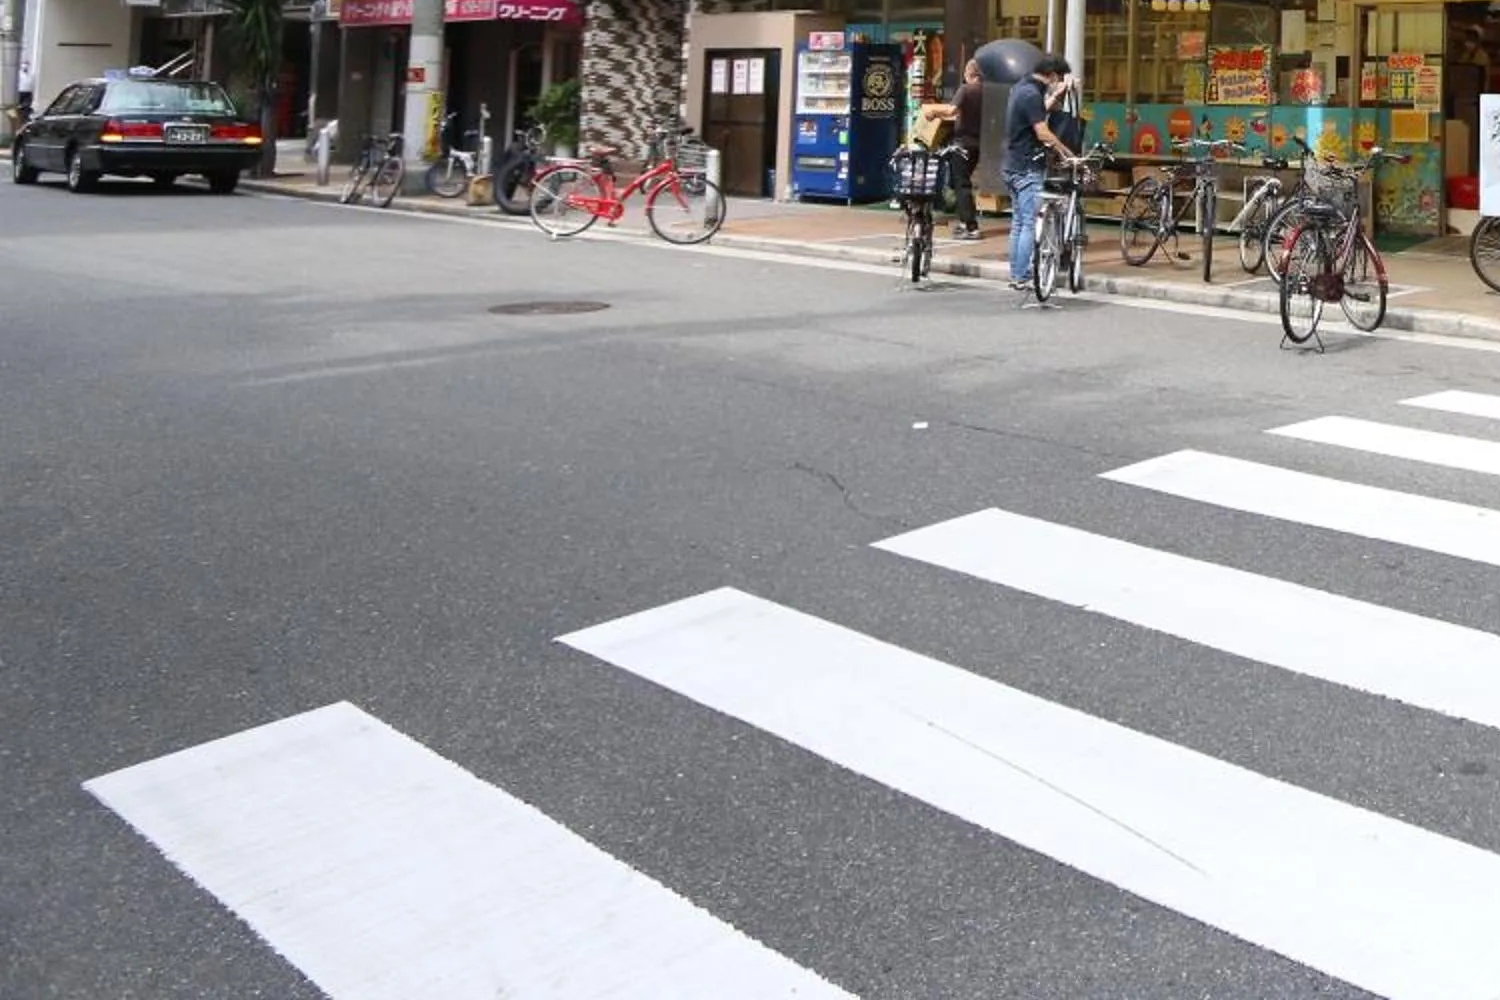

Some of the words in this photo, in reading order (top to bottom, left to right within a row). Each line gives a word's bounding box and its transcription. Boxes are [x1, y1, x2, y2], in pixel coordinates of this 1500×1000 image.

[500, 6, 567, 20] クリーニング
[861, 98, 895, 111] BOSS
